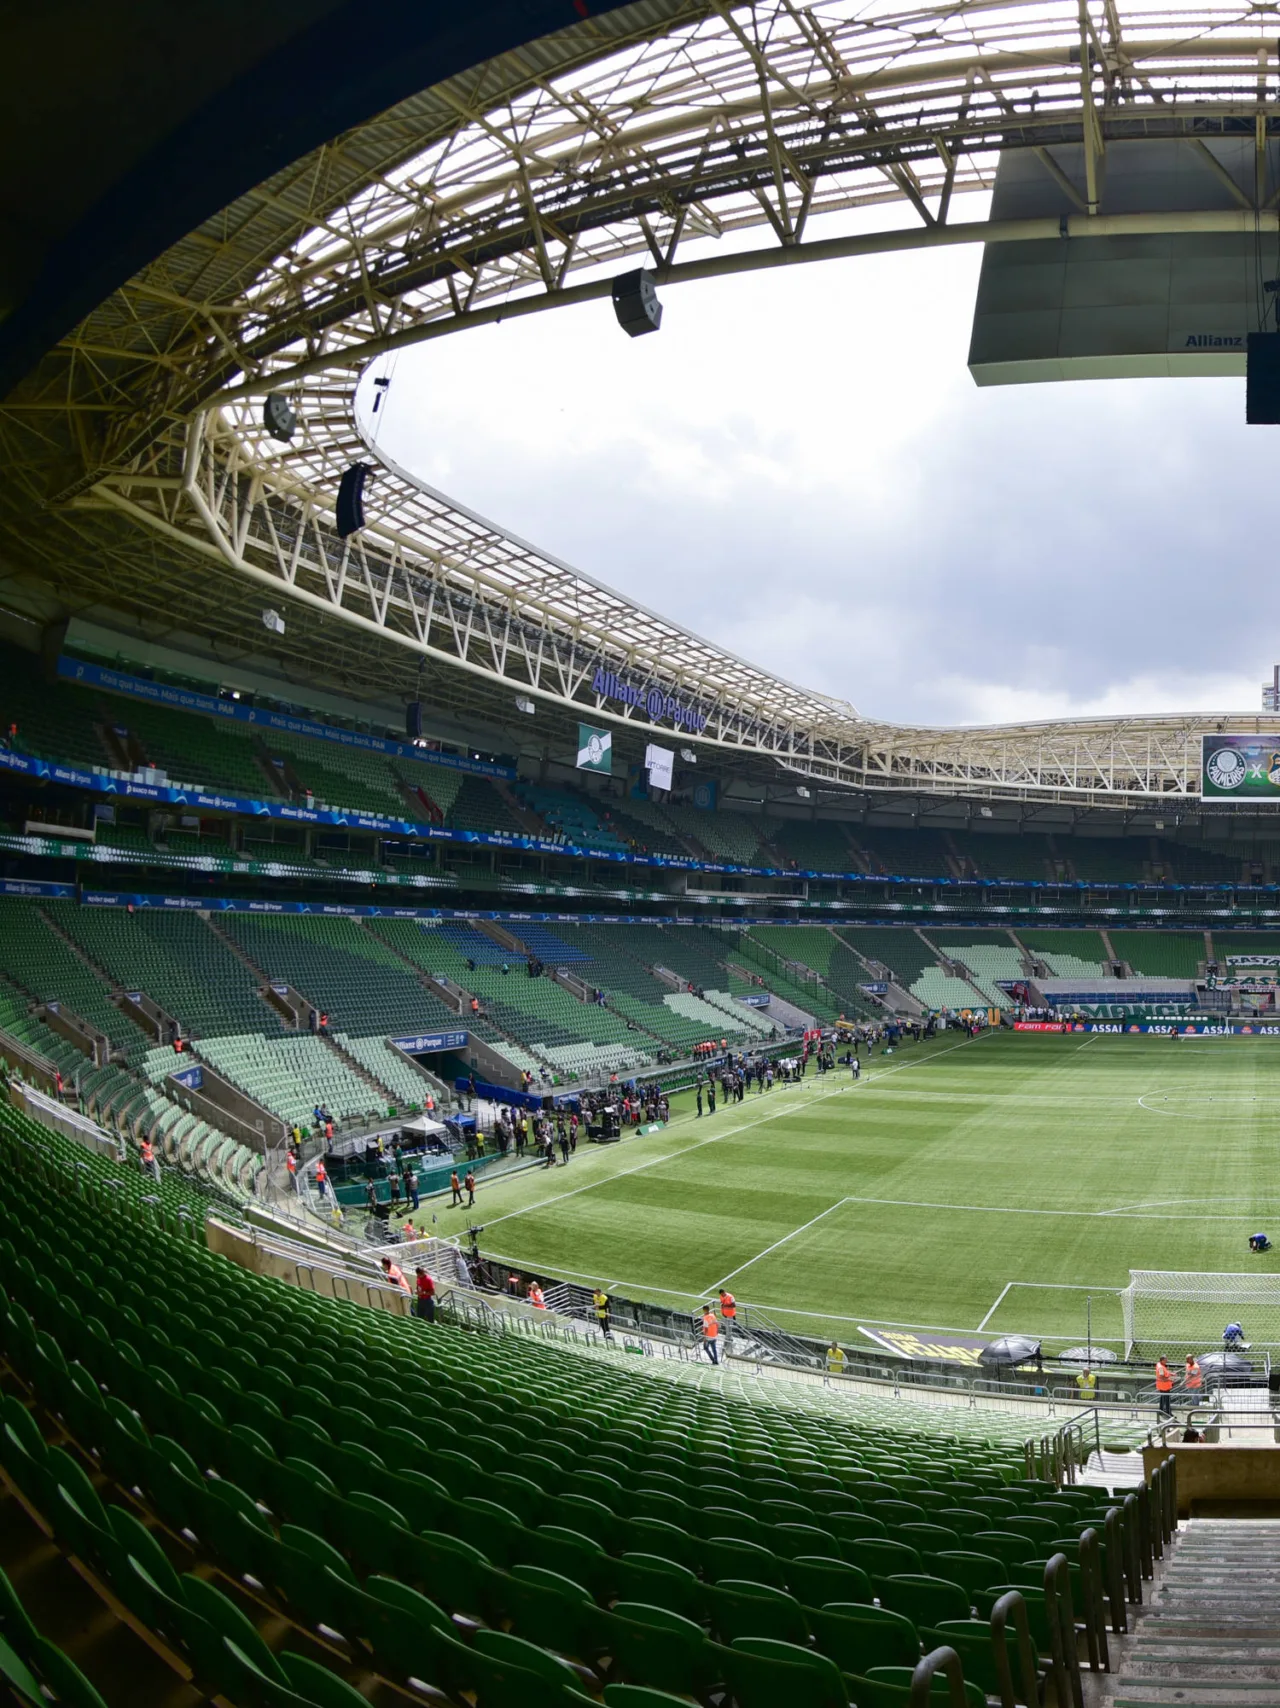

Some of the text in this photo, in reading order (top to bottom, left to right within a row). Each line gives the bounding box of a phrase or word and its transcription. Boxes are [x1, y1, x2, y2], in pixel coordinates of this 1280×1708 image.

[1185, 335, 1242, 347] Allianz
[592, 667, 707, 732] Allianz Parque
[1209, 765, 1245, 787] PALMEIRAS
[1251, 763, 1262, 779] X
[1227, 956, 1280, 966] RASTA
[1148, 1025, 1174, 1033] ASSA
